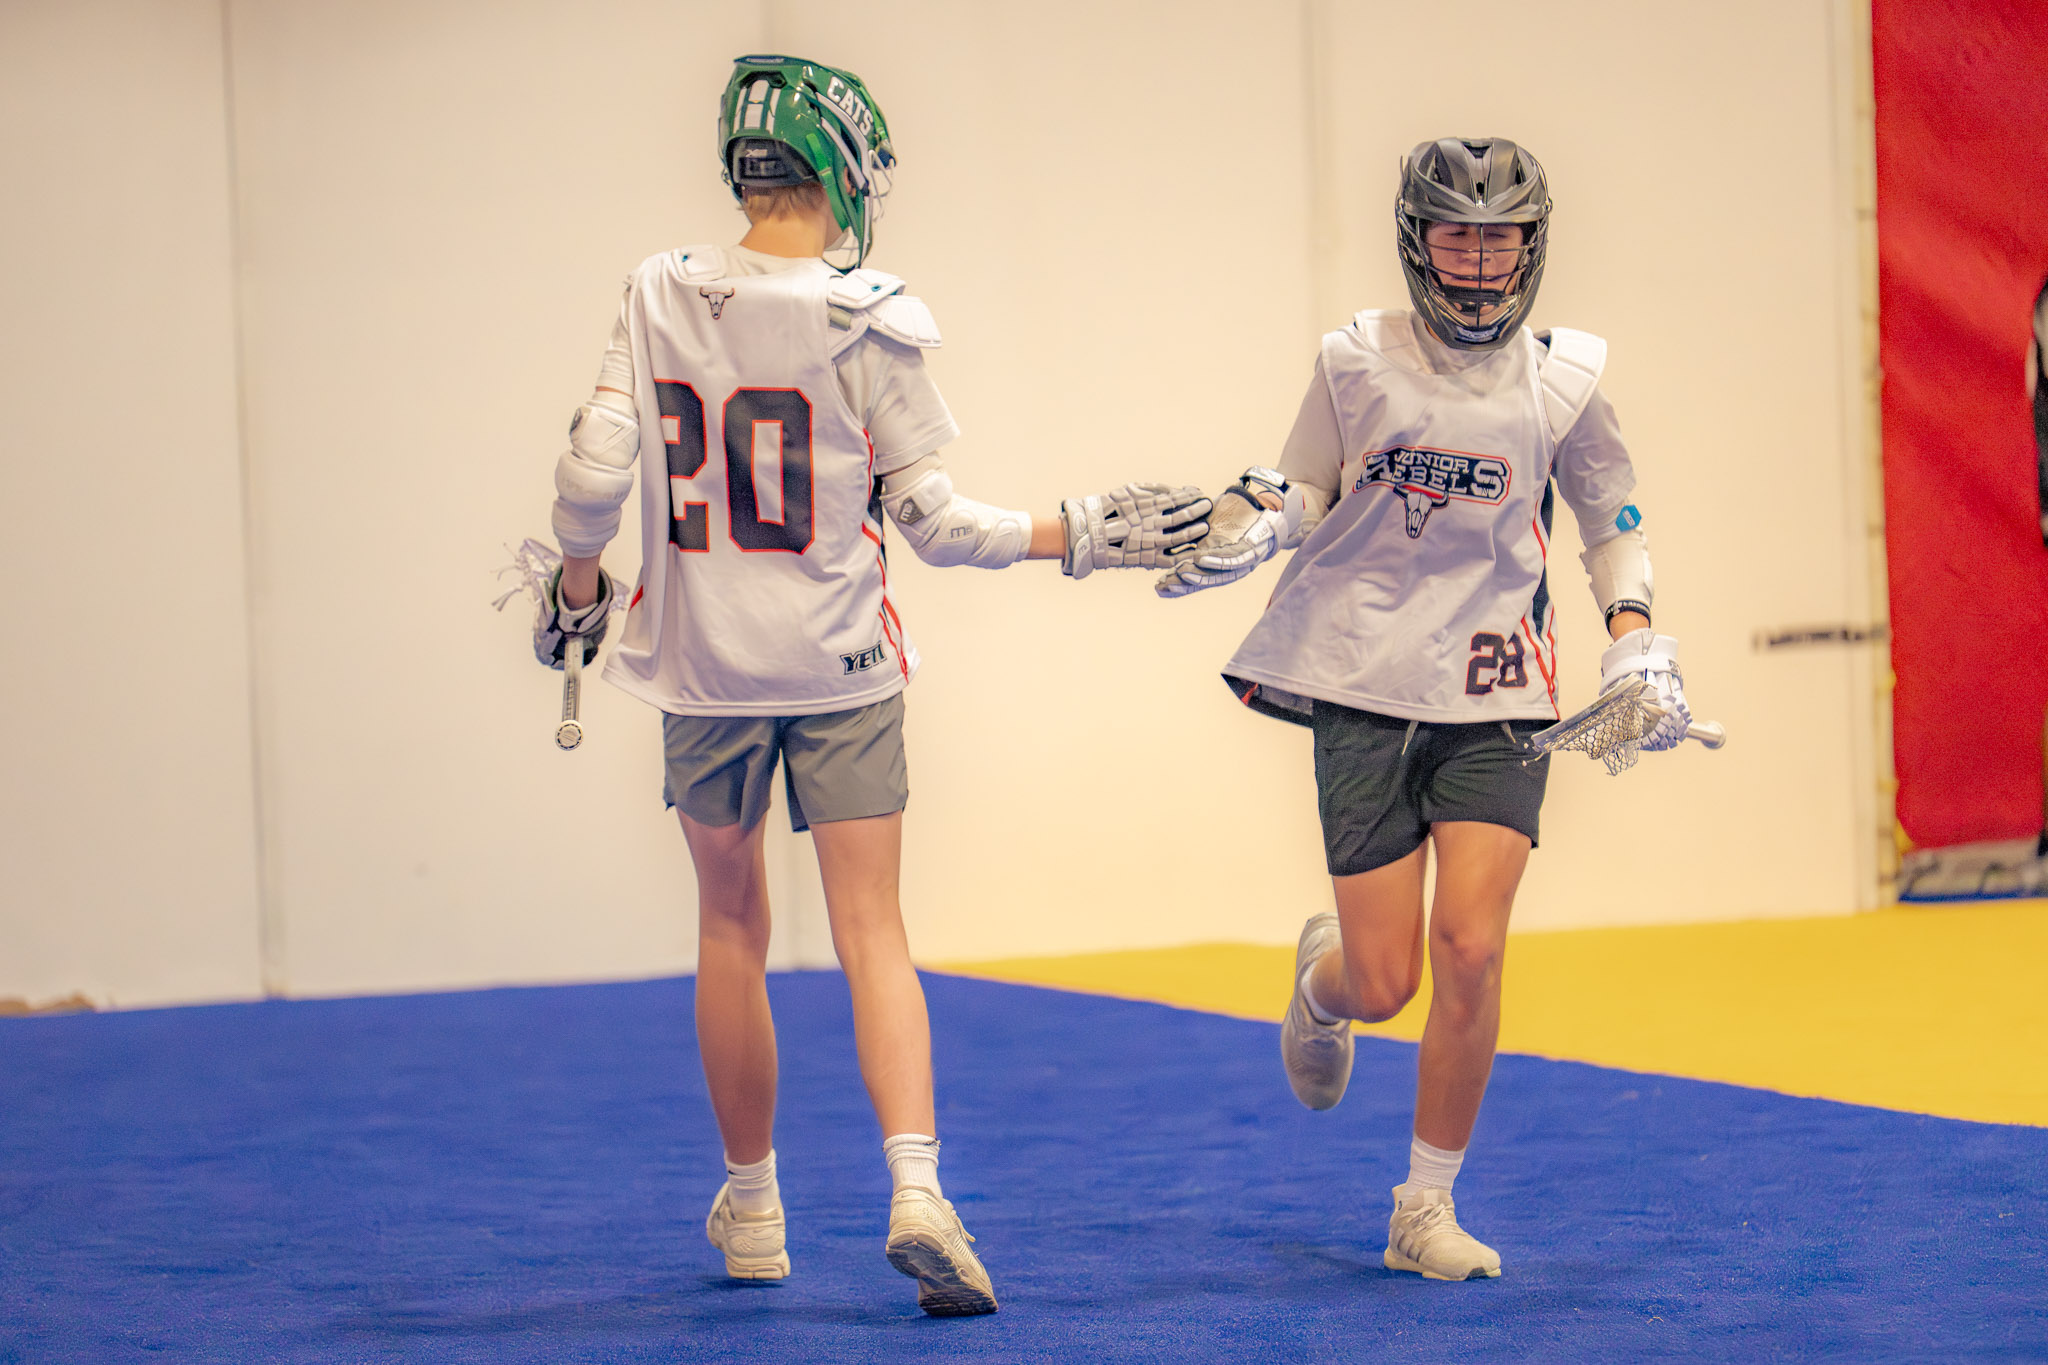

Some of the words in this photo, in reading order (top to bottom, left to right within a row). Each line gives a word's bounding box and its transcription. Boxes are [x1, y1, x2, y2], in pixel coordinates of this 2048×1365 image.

[827, 76, 874, 136] CATS
[654, 379, 816, 555] 20
[1356, 453, 1509, 499] REBELS
[1393, 450, 1470, 474] JUNIOR
[839, 640, 888, 675] YETI
[1465, 632, 1529, 695] 28
